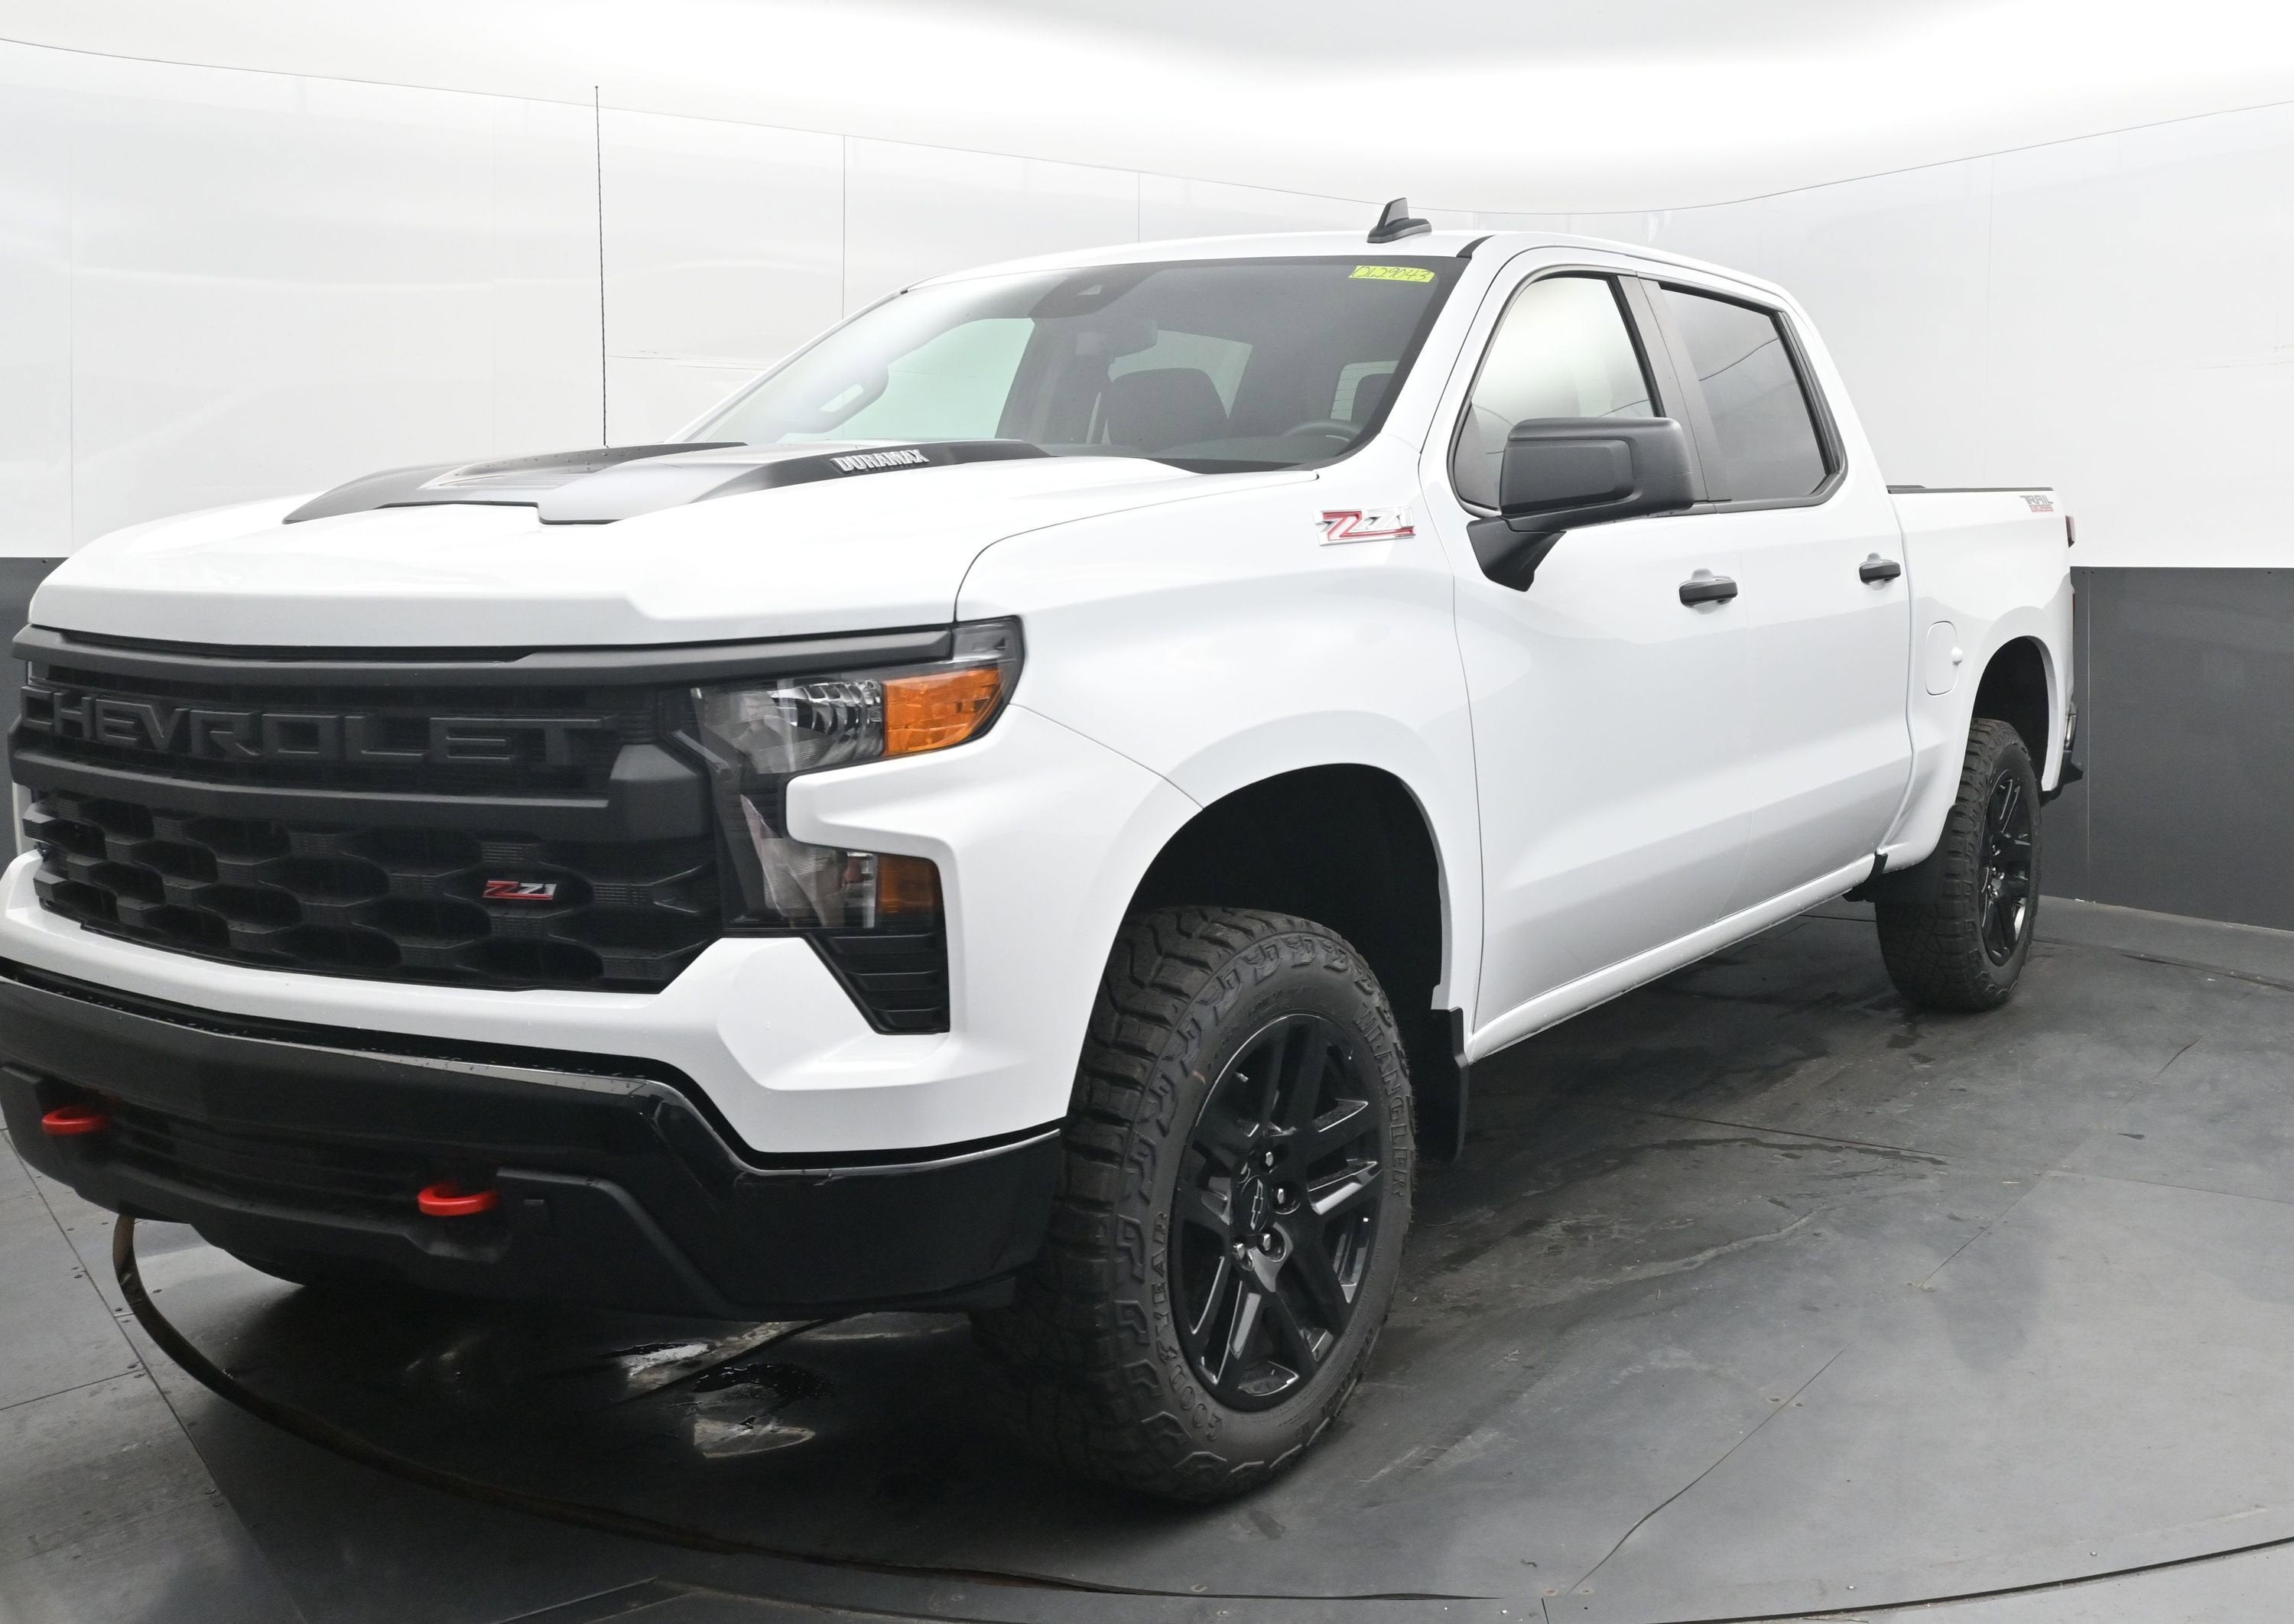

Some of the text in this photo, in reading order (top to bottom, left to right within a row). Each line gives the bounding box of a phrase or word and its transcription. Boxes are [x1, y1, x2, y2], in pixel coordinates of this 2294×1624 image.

[830, 449, 930, 472] DURAMAX
[2019, 495, 2054, 505] TRAIL
[1312, 506, 1416, 547] Z71
[21, 684, 614, 766] CHEVROLET
[483, 880, 557, 901] Z71
[1352, 1002, 1408, 1196] WRANGLER
[1151, 1212, 1223, 1442] GOODYEAR
